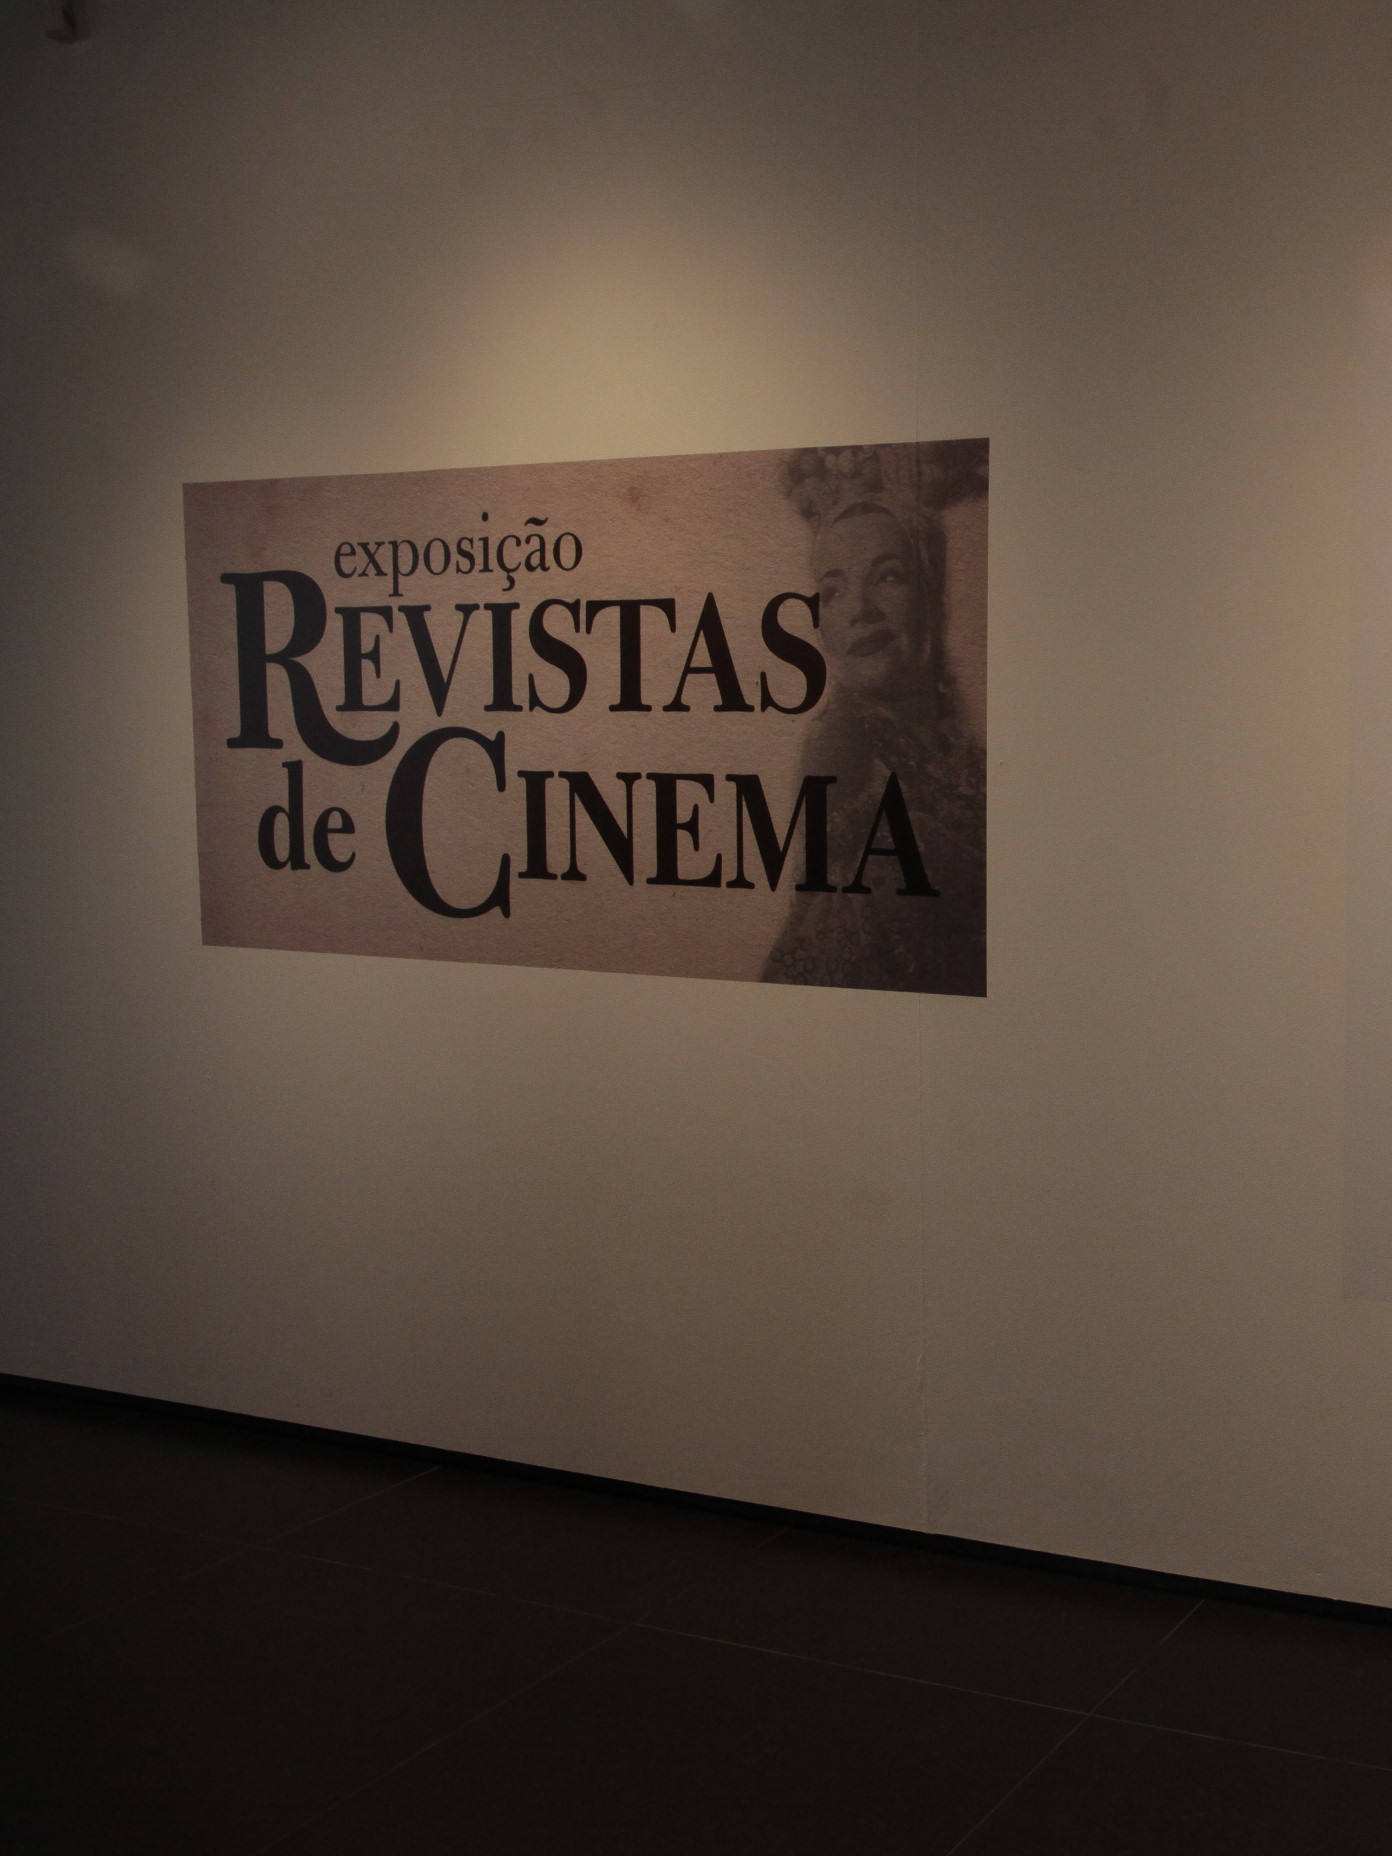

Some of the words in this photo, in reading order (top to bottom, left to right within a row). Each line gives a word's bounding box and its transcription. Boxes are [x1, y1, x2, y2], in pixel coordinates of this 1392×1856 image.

[333, 511, 583, 597] exposição
[220, 569, 828, 767] REVISTAS
[258, 759, 357, 873] de
[384, 726, 941, 919] CINEMA
